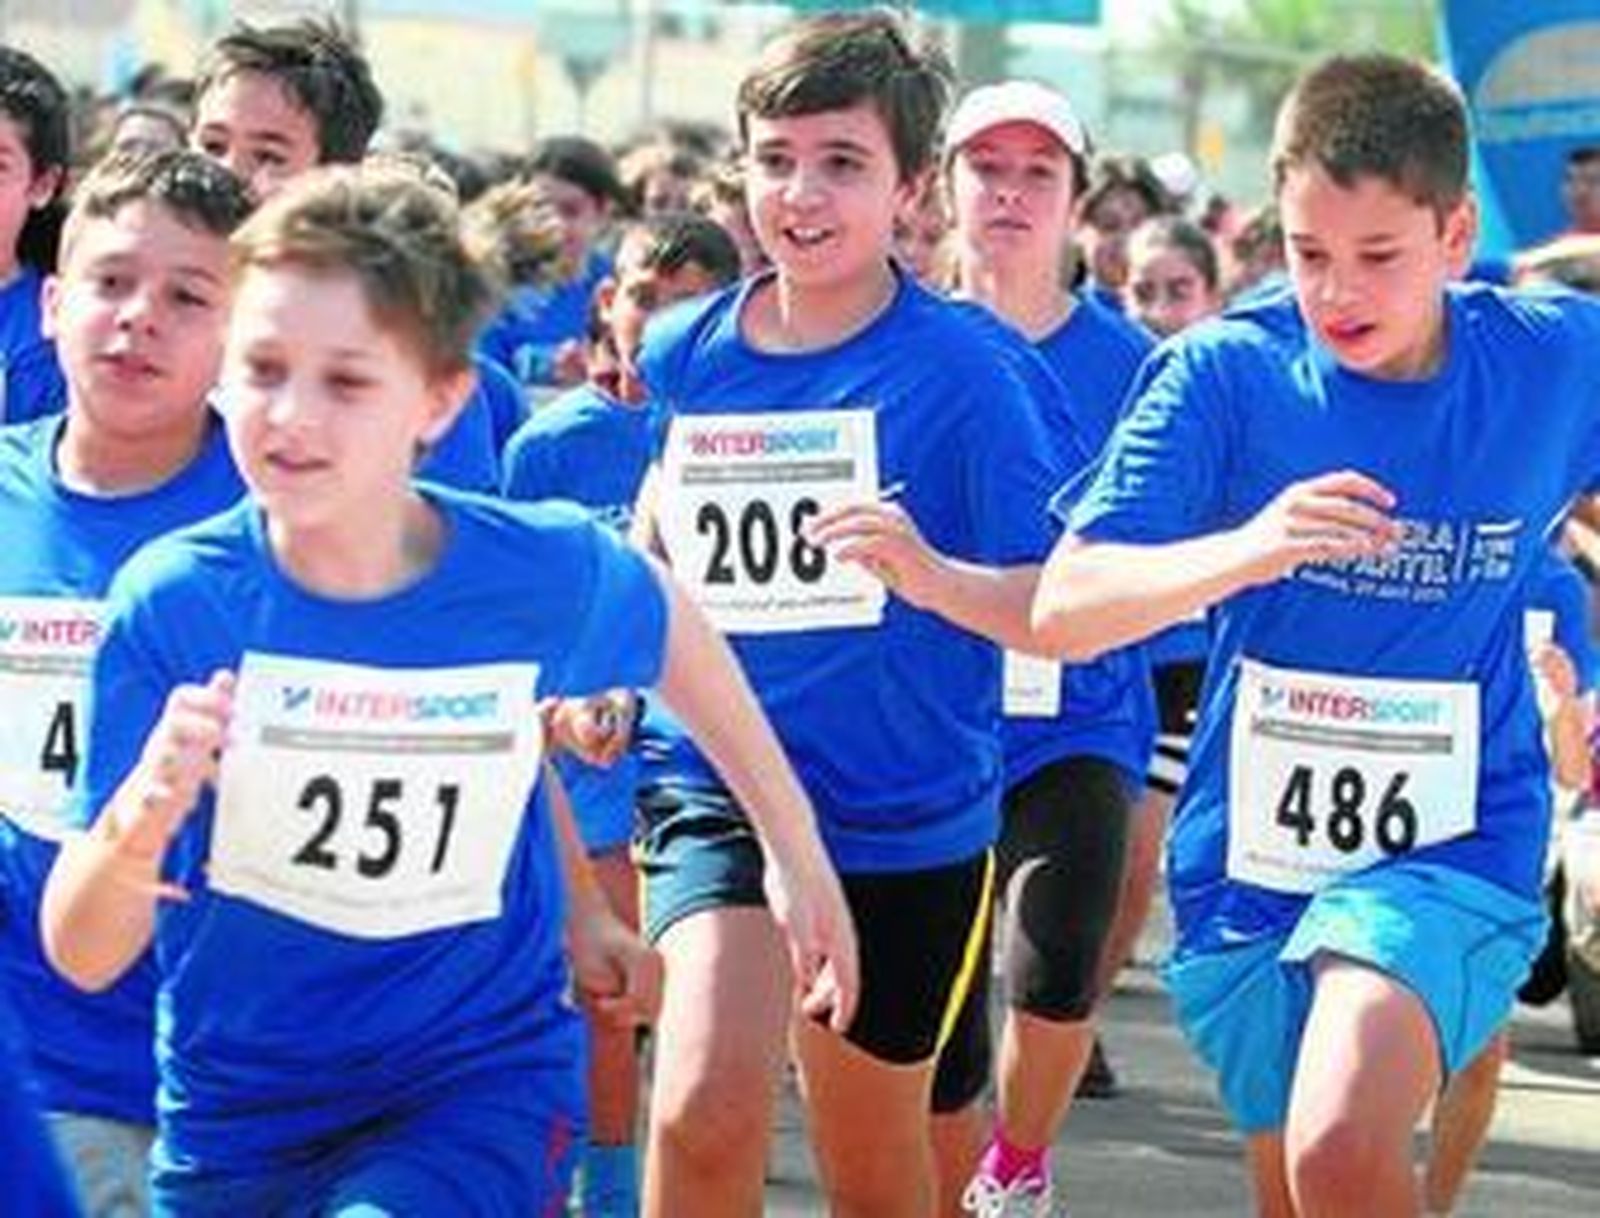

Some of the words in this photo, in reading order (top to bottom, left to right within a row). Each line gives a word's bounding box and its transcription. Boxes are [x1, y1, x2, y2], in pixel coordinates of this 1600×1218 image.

[696, 497, 827, 585] 208
[41, 701, 79, 789] 4
[1288, 686, 1441, 725] INTERSPORT
[291, 775, 460, 879] 251
[1276, 763, 1418, 856] 486
